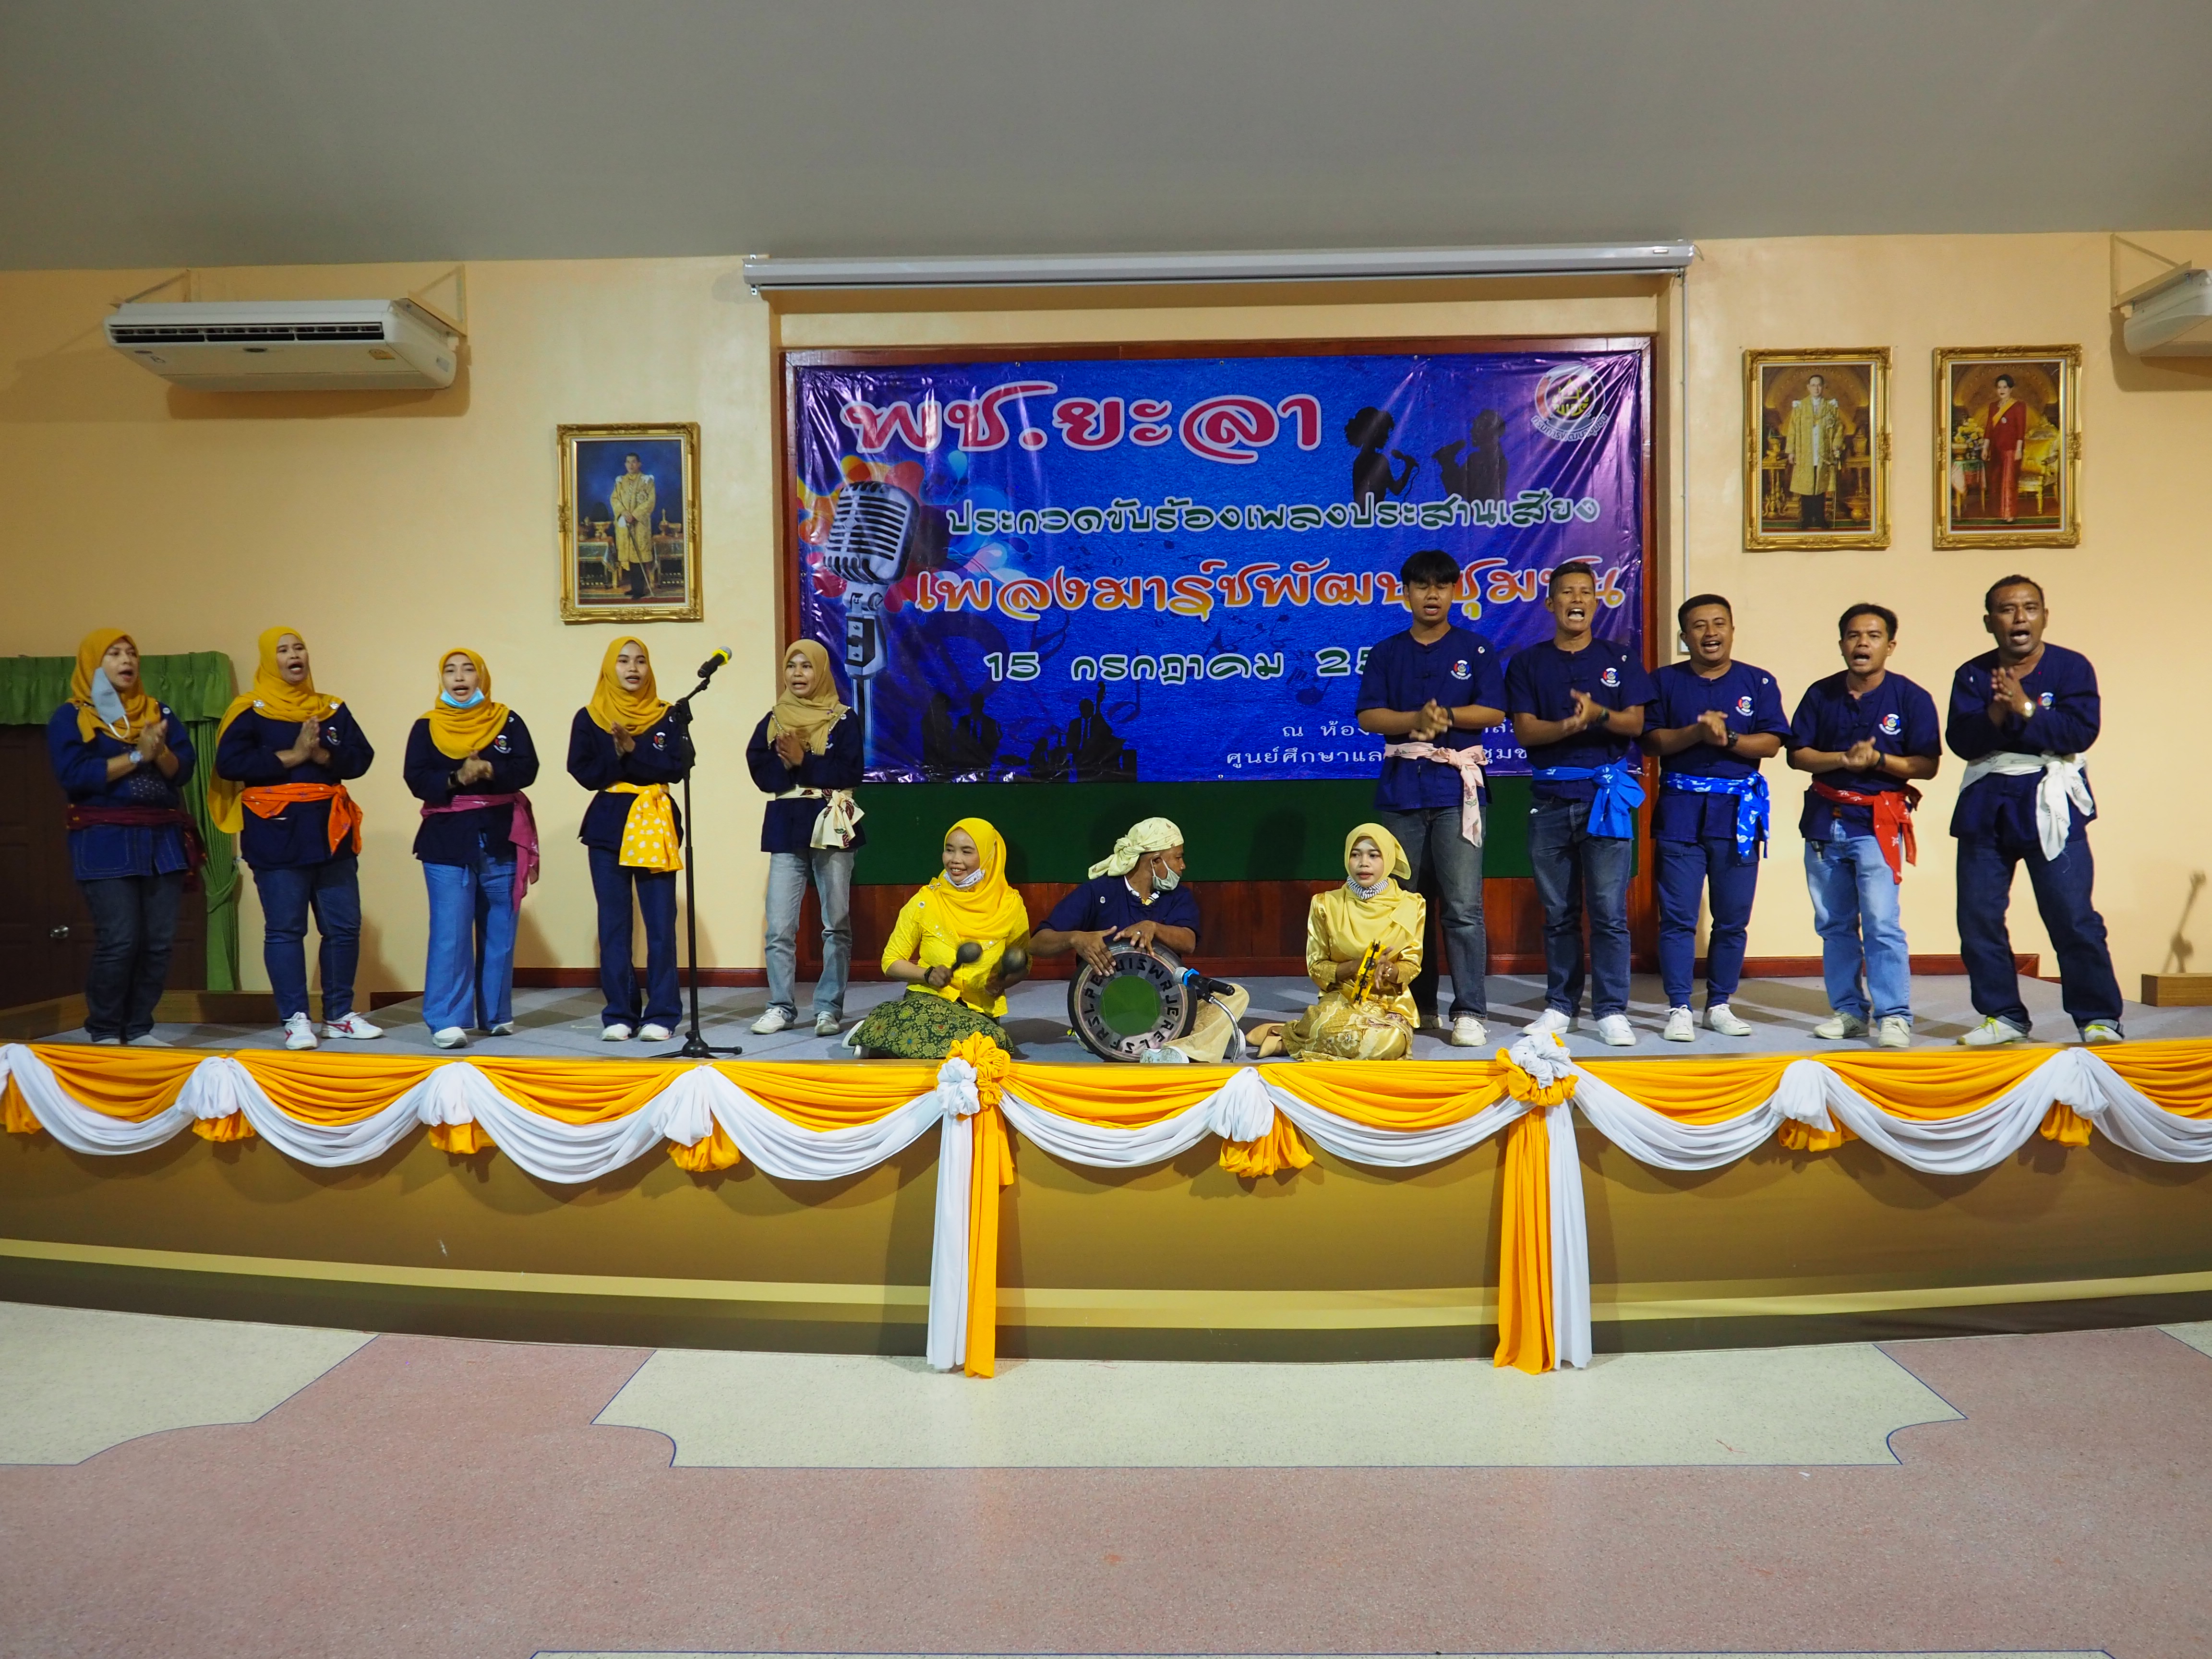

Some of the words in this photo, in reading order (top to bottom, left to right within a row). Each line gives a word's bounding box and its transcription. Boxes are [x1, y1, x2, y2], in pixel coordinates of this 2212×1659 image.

[842, 381, 1321, 464] พช.ยะลา
[946, 488, 1600, 535] ประกวดขับร้องเพลงประสานเสียง
[984, 651, 1041, 681] 15
[1071, 652, 1284, 685] กรกฎาคม
[1282, 726, 1304, 736] ณ
